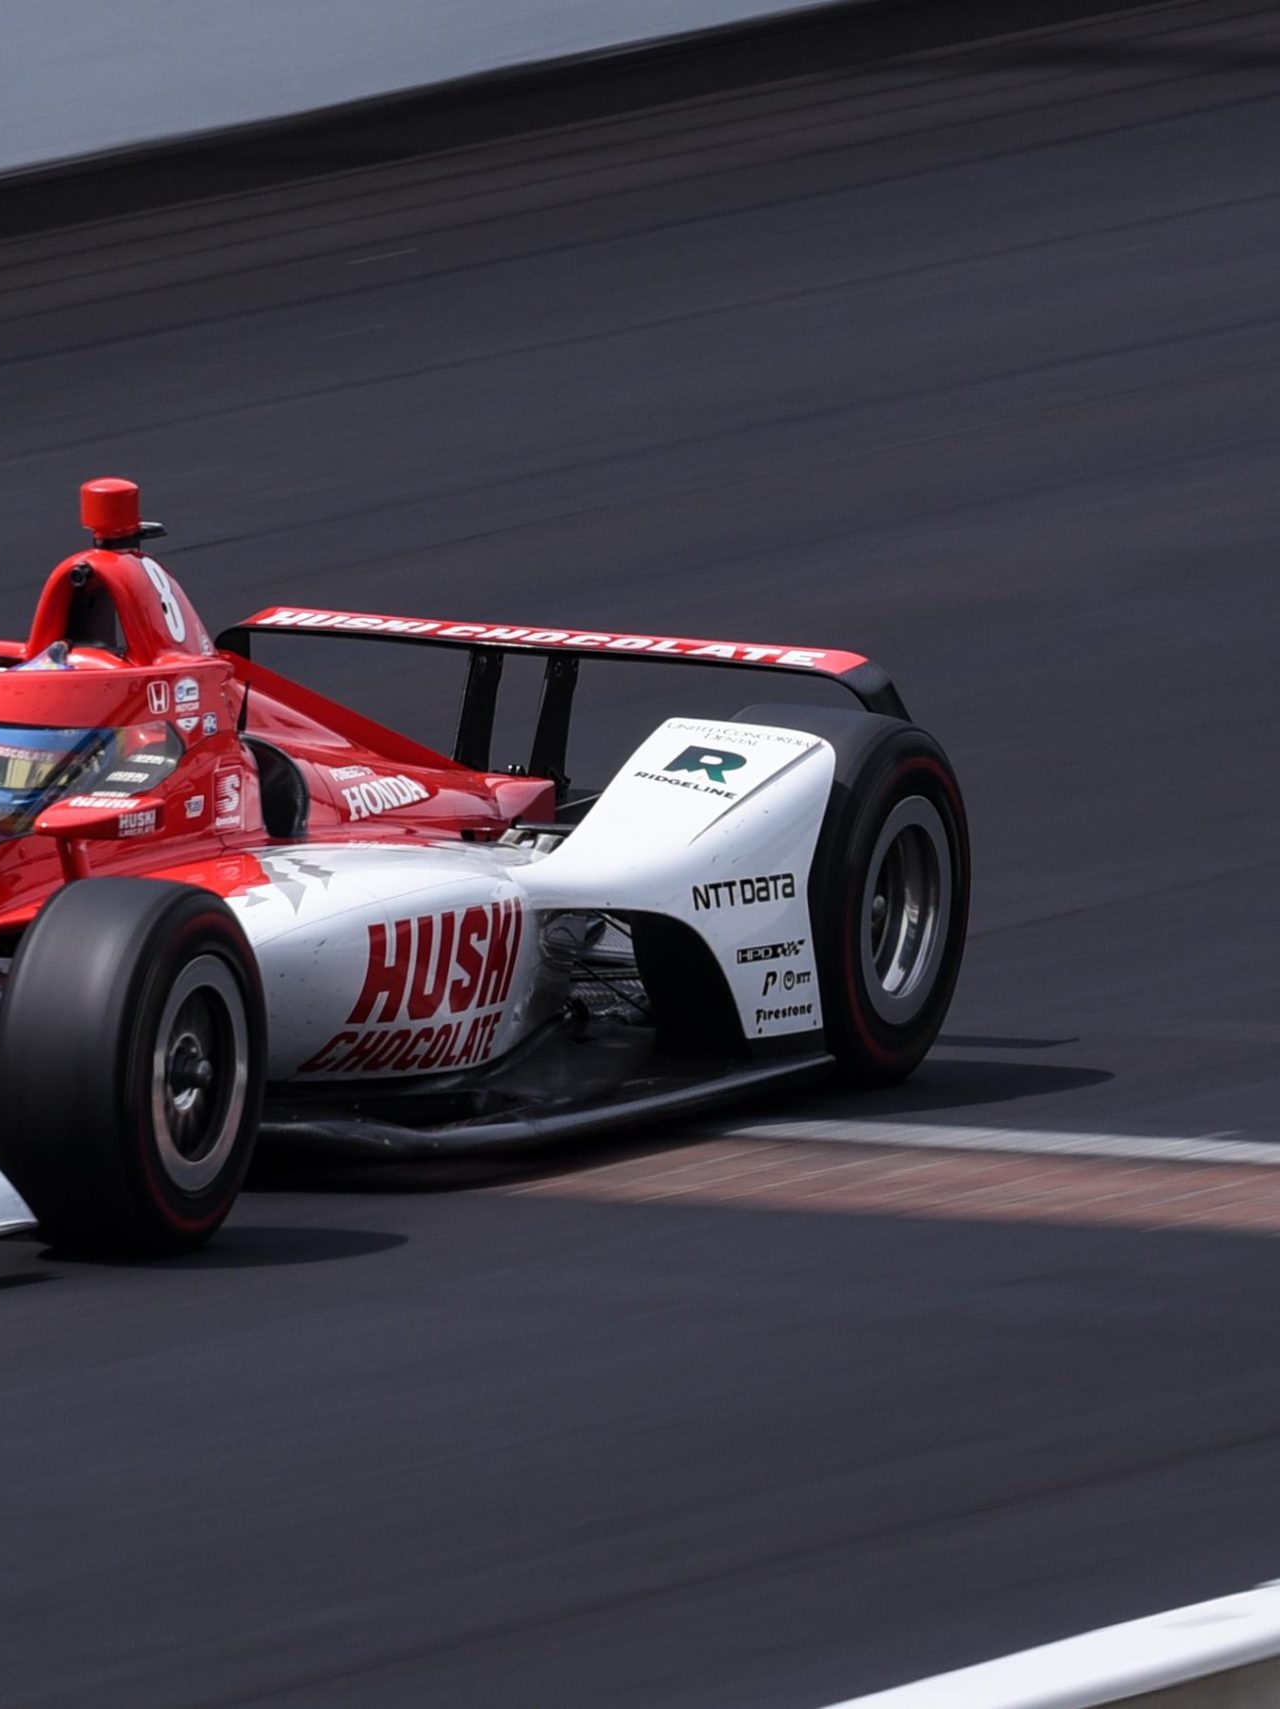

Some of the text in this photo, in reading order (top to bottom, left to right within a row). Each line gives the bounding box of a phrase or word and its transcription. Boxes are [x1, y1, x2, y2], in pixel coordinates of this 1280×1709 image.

[140, 556, 186, 643] 8
[256, 611, 826, 668] HUSKI CHOCOLATE
[341, 774, 430, 822] HONDA
[634, 770, 738, 800] RIDGELINE
[118, 809, 156, 830] HUSKI
[693, 883, 737, 911] NTT
[345, 896, 523, 1025] HUSKI
[738, 947, 773, 963] HPD
[755, 1003, 813, 1024] Firestone
[296, 1011, 504, 1073] CHOCOLATE
